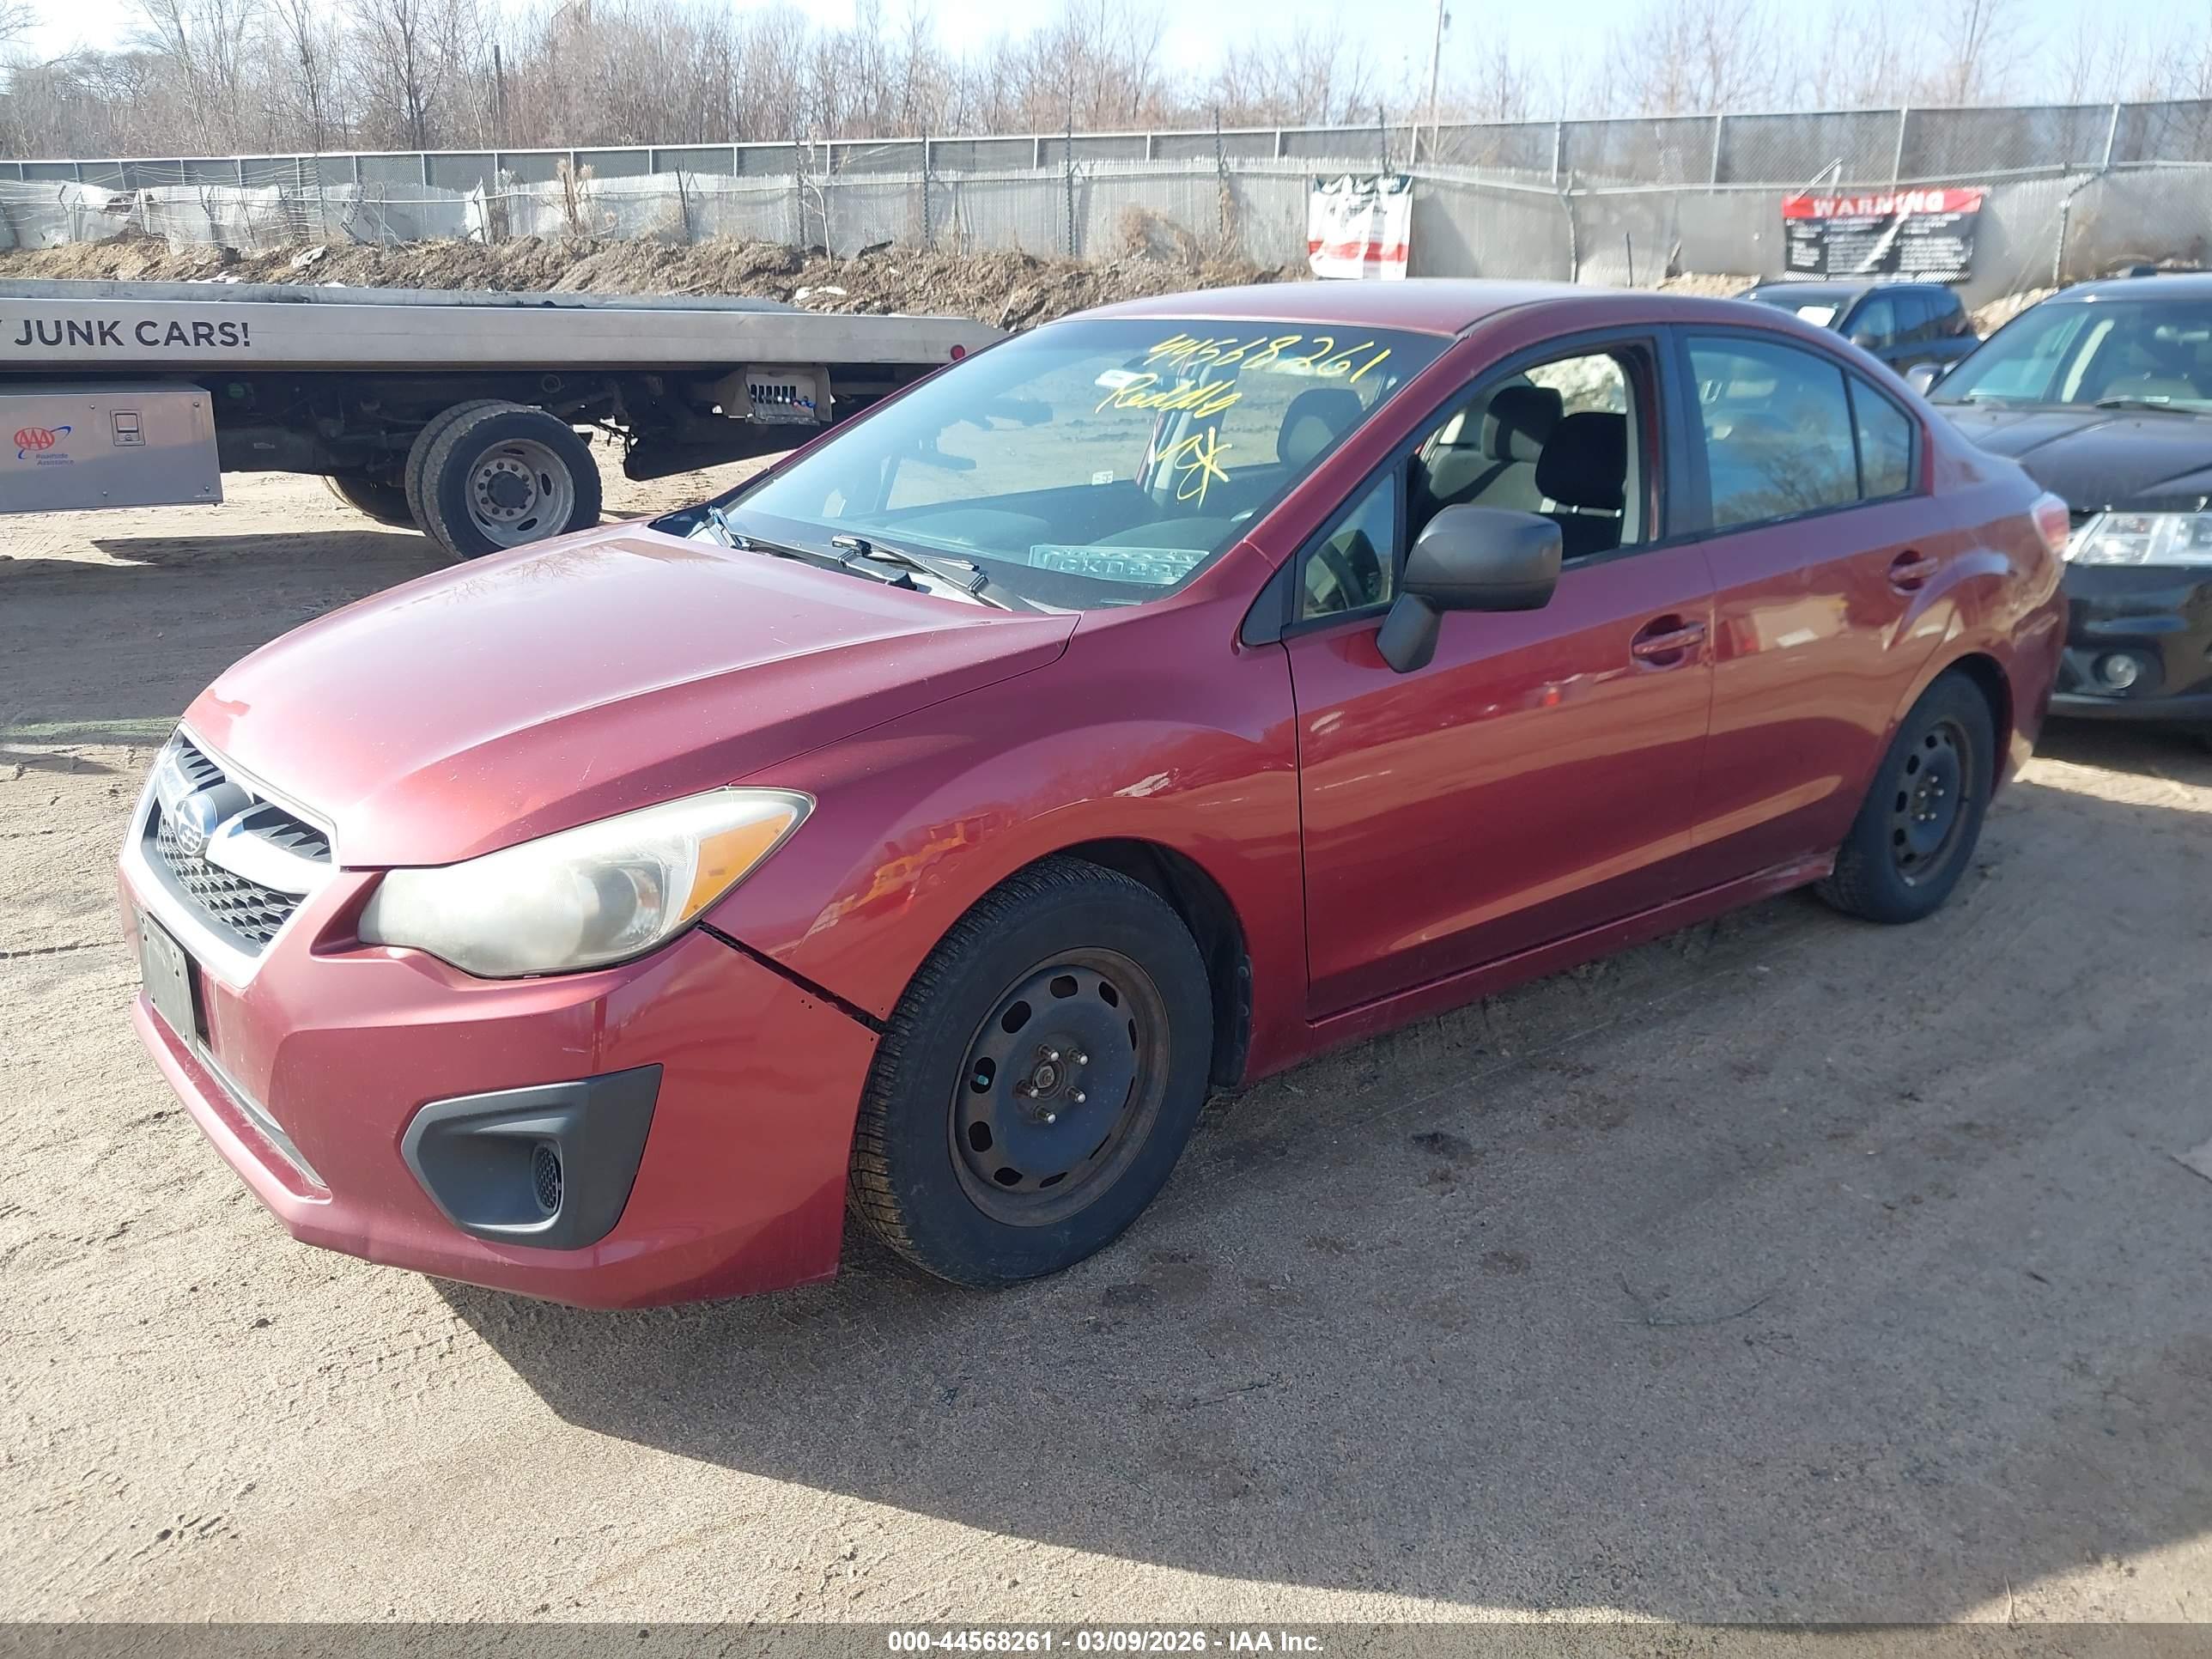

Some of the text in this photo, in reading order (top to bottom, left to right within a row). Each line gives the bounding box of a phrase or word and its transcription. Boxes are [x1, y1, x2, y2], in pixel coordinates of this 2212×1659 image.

[1813, 191, 1945, 217] WARNING
[15, 319, 251, 347] JUNK CARS!
[1143, 334, 1392, 383] 44568261
[17, 428, 52, 450] AAA
